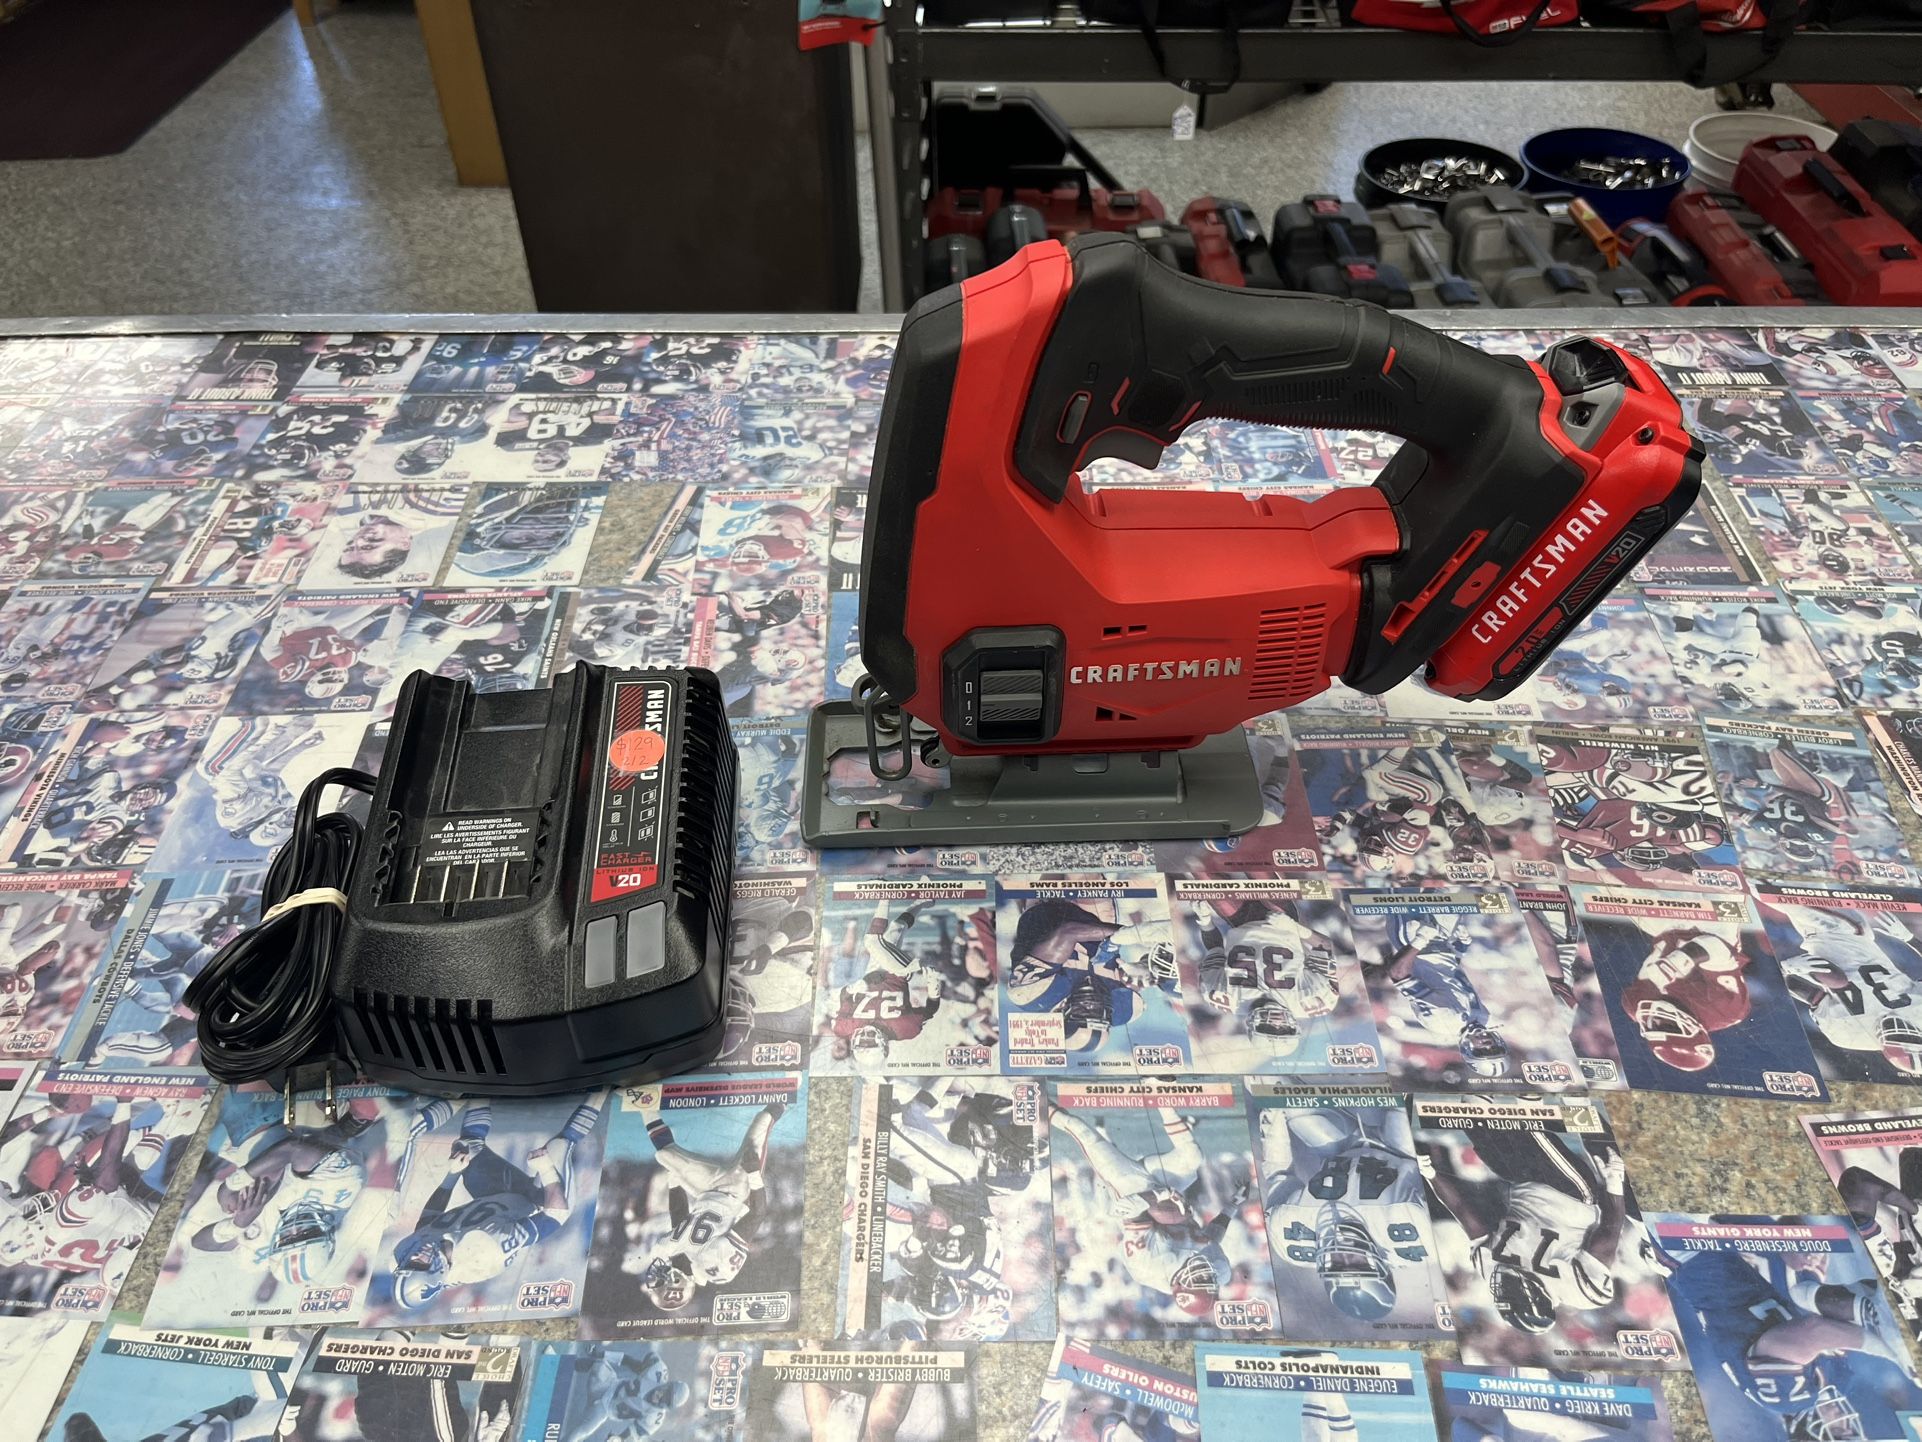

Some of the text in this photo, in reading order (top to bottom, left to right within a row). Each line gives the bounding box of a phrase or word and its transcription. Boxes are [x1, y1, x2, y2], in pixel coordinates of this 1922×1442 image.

[1677, 371, 1771, 385] THINK ABOUT IT
[1606, 537, 1634, 565] V20
[1471, 499, 1609, 644] CRAFTSMAN
[1069, 657, 1242, 684] CRAFTSMAN
[967, 700, 971, 710] 1
[965, 716, 973, 726] 2
[640, 689, 665, 780] CSMAN
[1728, 721, 1829, 737] GREEN BAY PACKERS
[616, 737, 653, 757] $129
[1578, 740, 1659, 752] NFL NEWSREEL
[600, 857, 652, 865] CHARGER
[0, 880, 117, 891] MARK CARRIER WIDE RECEI
[609, 874, 641, 887] V20
[856, 882, 914, 890] CARDINALS
[1182, 881, 1291, 890] PHOENIX CARDINALS
[854, 890, 966, 900] JAY TAYLOR CORNERBACK
[1036, 890, 1124, 898] IRV PANKEY TACKLE
[1372, 895, 1452, 904] DETROIT LIONS
[1781, 887, 1893, 901] CLEVELAND BROWNS
[1592, 895, 1701, 909] KANSAS CITY CHIEFS
[1776, 895, 1907, 912] KEVIN MACK RUNNING BACK
[1354, 905, 1478, 915] REGGIE BARRETT WIDE RECEIVER
[1587, 903, 1713, 921] TIM BARNETT WIDE RECEIVER
[1226, 945, 1296, 990] 35
[851, 988, 902, 1019] 27
[57, 1073, 196, 1085] NEW ENGLAND PATRIOTS
[1086, 1086, 1125, 1094] CHIEFS
[1128, 1086, 1153, 1094] CITY
[1272, 1086, 1315, 1095] EAGLES
[669, 1093, 787, 1107] DANNY LOCKETT LONDON
[1072, 1096, 1220, 1106] BARRY WORD RUNNING BACK
[1286, 1096, 1397, 1108] WES HOPKINS SAFETY
[1422, 1105, 1555, 1116] SAN DIEGO CHARGERS
[1439, 1118, 1544, 1130] ERIC MOTEN GUARD
[1308, 1156, 1398, 1200] 48
[854, 1138, 871, 1262] SAN DIEGO CHARGERS
[869, 1131, 888, 1273] BILLY RAY SMITH LINEBACKER
[1692, 1226, 1812, 1238] NEW YORK GIANTS
[1492, 1221, 1560, 1278] 77
[1682, 1238, 1831, 1252] DOUG RIESENBERG TACKLE
[155, 1333, 252, 1351] NEW YORK JETS
[1621, 1334, 1671, 1347] NFL SET
[118, 1342, 276, 1370] TONY STARGELL CORNERBACK
[326, 1342, 473, 1360] SAN DIEGO CHARGERS
[1625, 1344, 1652, 1356] PRO
[789, 1353, 938, 1366] PITTSBURGH STEELERS
[335, 1359, 452, 1378] ERIC MOTEN GUARD
[775, 1367, 951, 1381] BUBBY BRISTER QUARTERBACK
[1235, 1359, 1380, 1376] INDIANAPOLIS COLTS
[1103, 1363, 1196, 1403] USTON OILERS
[1223, 1373, 1397, 1393] EUGENE DANIEL CORNERBACK
[1479, 1378, 1615, 1399] SEATTLE SEAHAWKS
[1755, 1376, 1811, 1403] 72
[1081, 1371, 1194, 1420] McDOWELL SAFETY
[1468, 1391, 1632, 1417] DAVE KRIEG QUARTERBACK
